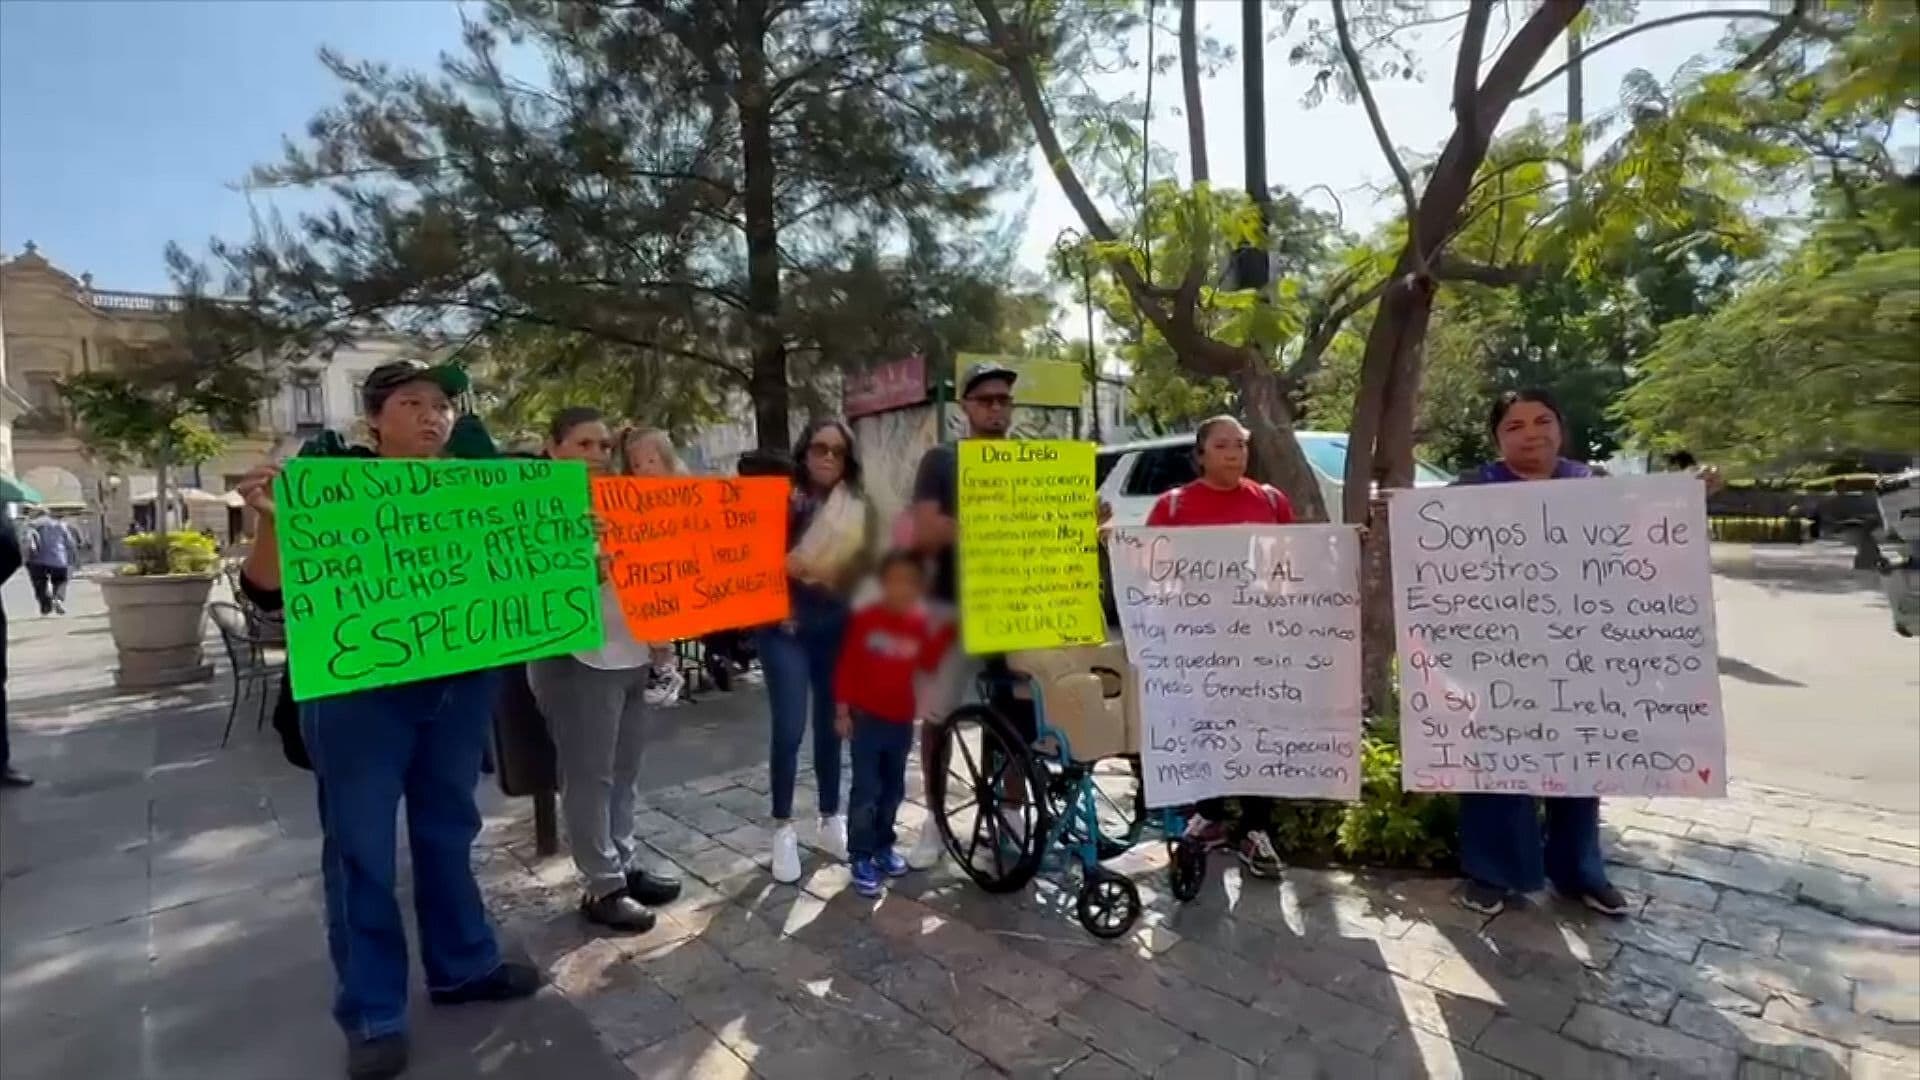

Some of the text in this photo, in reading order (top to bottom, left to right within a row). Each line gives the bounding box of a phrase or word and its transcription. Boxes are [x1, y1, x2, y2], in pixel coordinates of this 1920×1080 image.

[982, 442, 1058, 464] Dra Irela
[362, 462, 401, 500] SU
[408, 462, 508, 495] DESPIDO
[519, 462, 552, 481] NO
[290, 496, 564, 552] SOLO AFECTAS A LA
[724, 510, 757, 528] DRA
[1417, 500, 1689, 553] Somos la voz de
[290, 555, 362, 585] DRA
[484, 514, 592, 557] AFECTAS
[1149, 535, 1304, 583] GRACIAS AL
[1415, 551, 1658, 586] nuestros niños
[290, 593, 313, 622] A
[336, 563, 468, 611] MUCHOS
[1127, 586, 1212, 607] DESPIDO
[1573, 594, 1615, 615] los
[1627, 594, 1699, 617] cuales
[328, 586, 598, 681] ESPECIALES!
[1227, 620, 1252, 635] de
[1409, 622, 1705, 648] merecen ser escuchados
[1174, 652, 1240, 677] quedan
[1305, 654, 1335, 670] su
[1409, 648, 1702, 686] que piden de regreso
[1202, 672, 1302, 703] Genetista
[1410, 692, 1430, 712] a
[1445, 692, 1478, 711] su
[1490, 680, 1536, 710] Dra
[1256, 728, 1353, 758] Especiales
[1461, 722, 1559, 750] despido
[1429, 743, 1695, 774] INJUSTIFICADO
